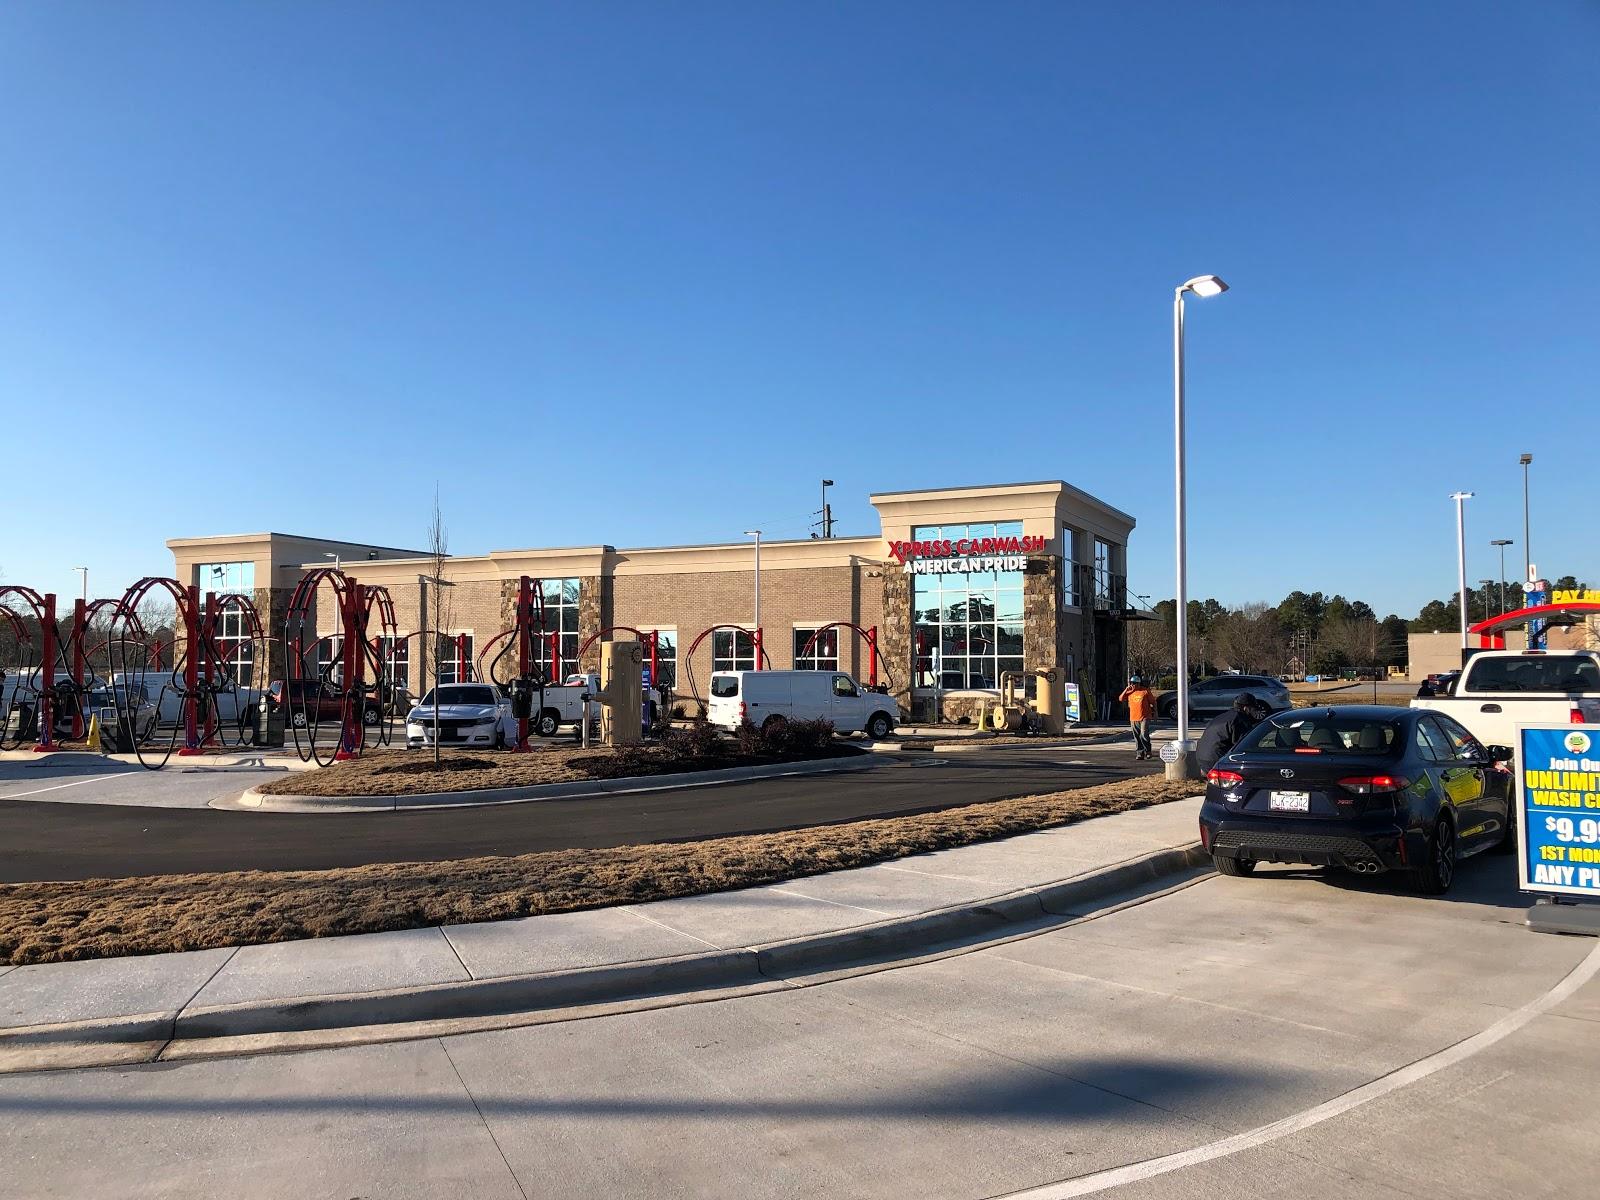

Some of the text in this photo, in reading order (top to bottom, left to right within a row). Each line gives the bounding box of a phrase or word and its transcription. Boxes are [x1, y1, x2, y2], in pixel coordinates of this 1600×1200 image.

[888, 536, 1045, 564] XPRESS CARWASH
[902, 556, 1028, 574] AMERICAN PRIDE
[1551, 589, 1579, 603] PAY
[1549, 757, 1579, 771] Join
[1532, 790, 1581, 808] WASH
[1545, 816, 1600, 843] $9.9
[1539, 845, 1566, 861] 1ST
[1534, 863, 1575, 886] ANY
